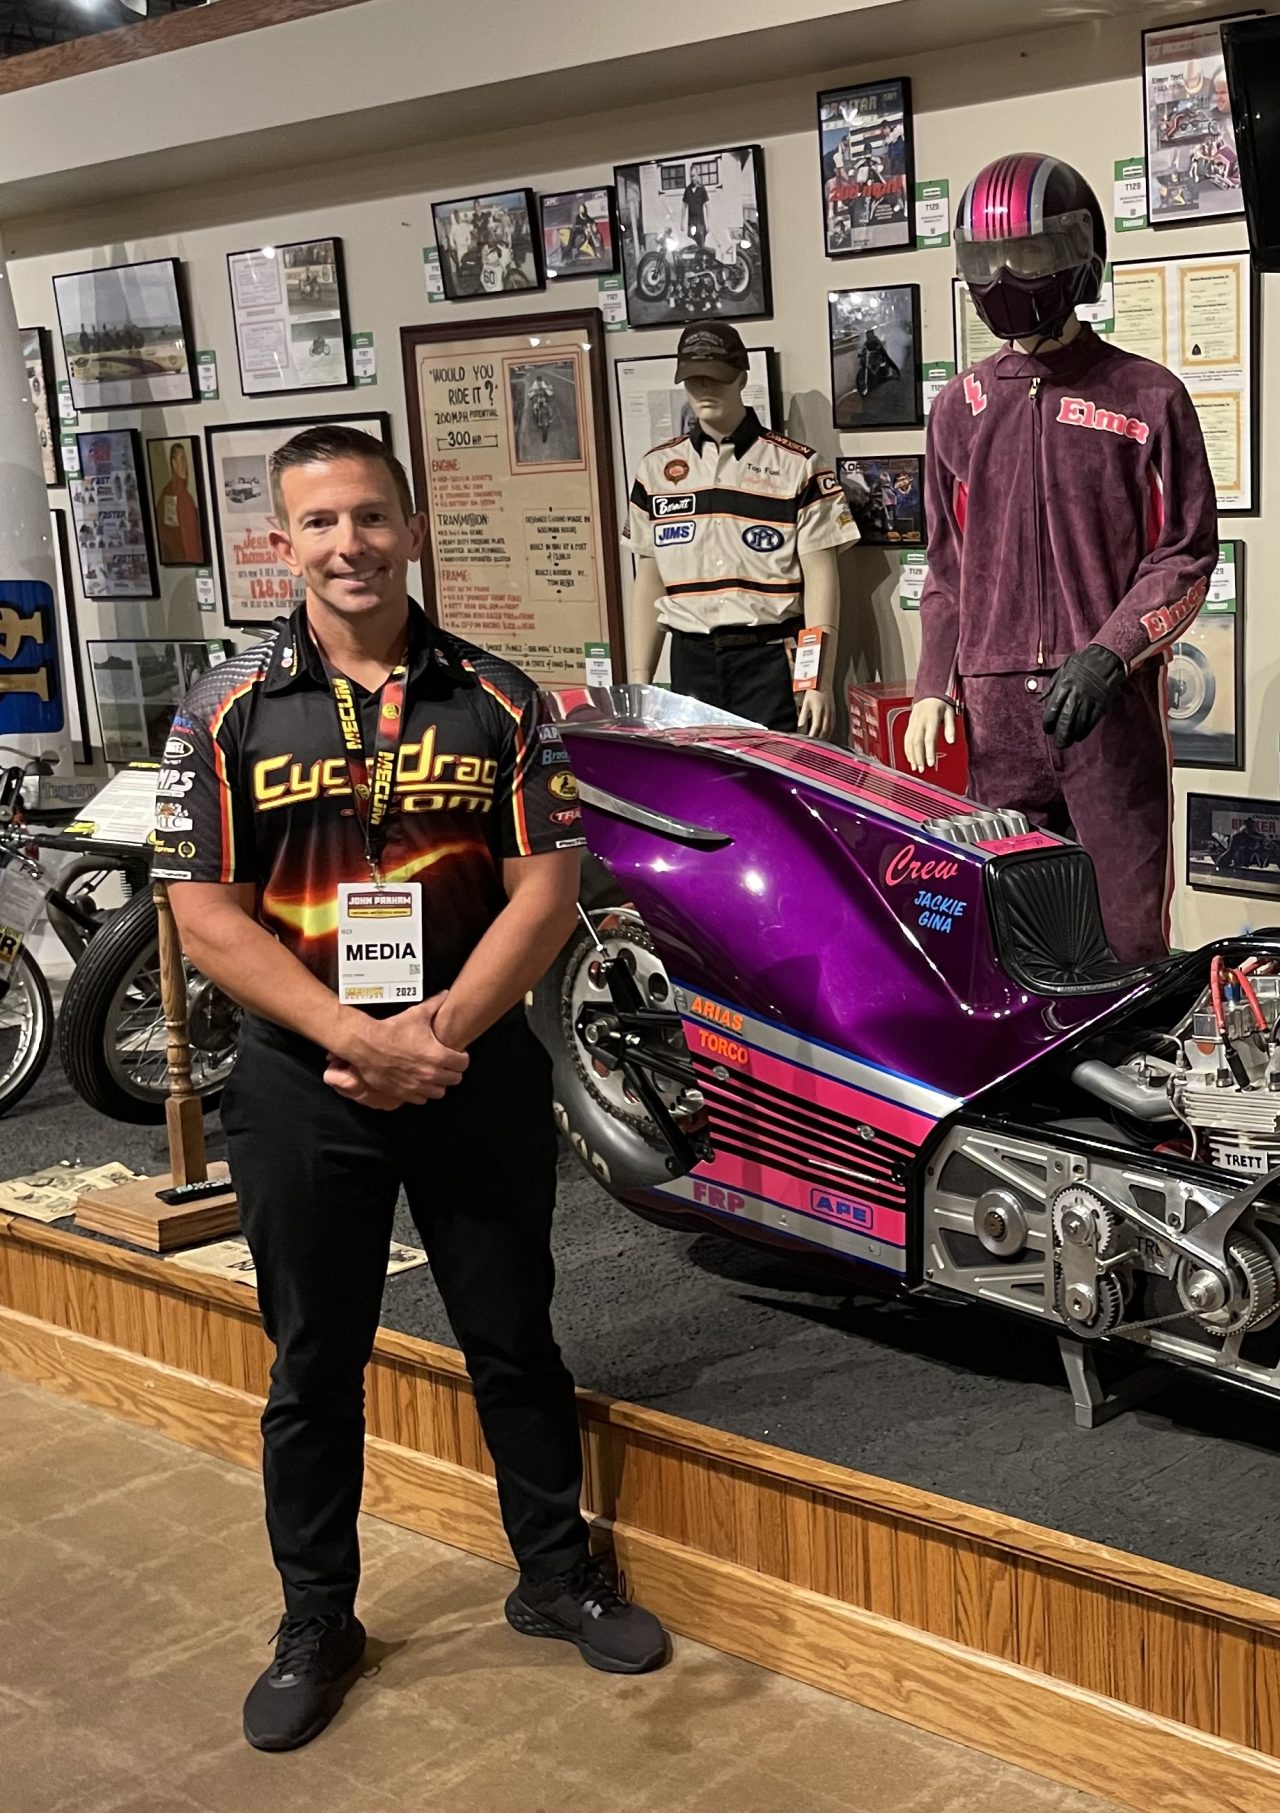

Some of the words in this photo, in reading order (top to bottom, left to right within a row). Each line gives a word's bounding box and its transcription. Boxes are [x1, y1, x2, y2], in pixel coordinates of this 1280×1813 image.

[483, 269, 496, 286] 60
[472, 364, 494, 381] YOU
[448, 388, 469, 405] RIDE
[472, 386, 483, 404] IT
[1055, 396, 1150, 445] Elmer
[447, 431, 471, 447] 300
[746, 463, 762, 475] Top
[658, 525, 690, 542] JIMS
[233, 544, 277, 565] Thomas
[1140, 575, 1207, 643] Elmer
[331, 677, 363, 750] MECUM
[369, 750, 396, 826] MECUM
[885, 844, 959, 887] Crew
[348, 896, 373, 905] JOHN
[374, 896, 412, 905] PARHAM
[913, 890, 968, 918] JACKIE
[917, 911, 953, 934] GINA
[346, 942, 417, 961] MEDIA
[396, 986, 417, 997] 2023
[690, 996, 744, 1032] ARIAS
[698, 1029, 748, 1065] TORCO
[1224, 1154, 1263, 1169] TRETT
[692, 1180, 745, 1213] FRP
[816, 1196, 867, 1223] APE
